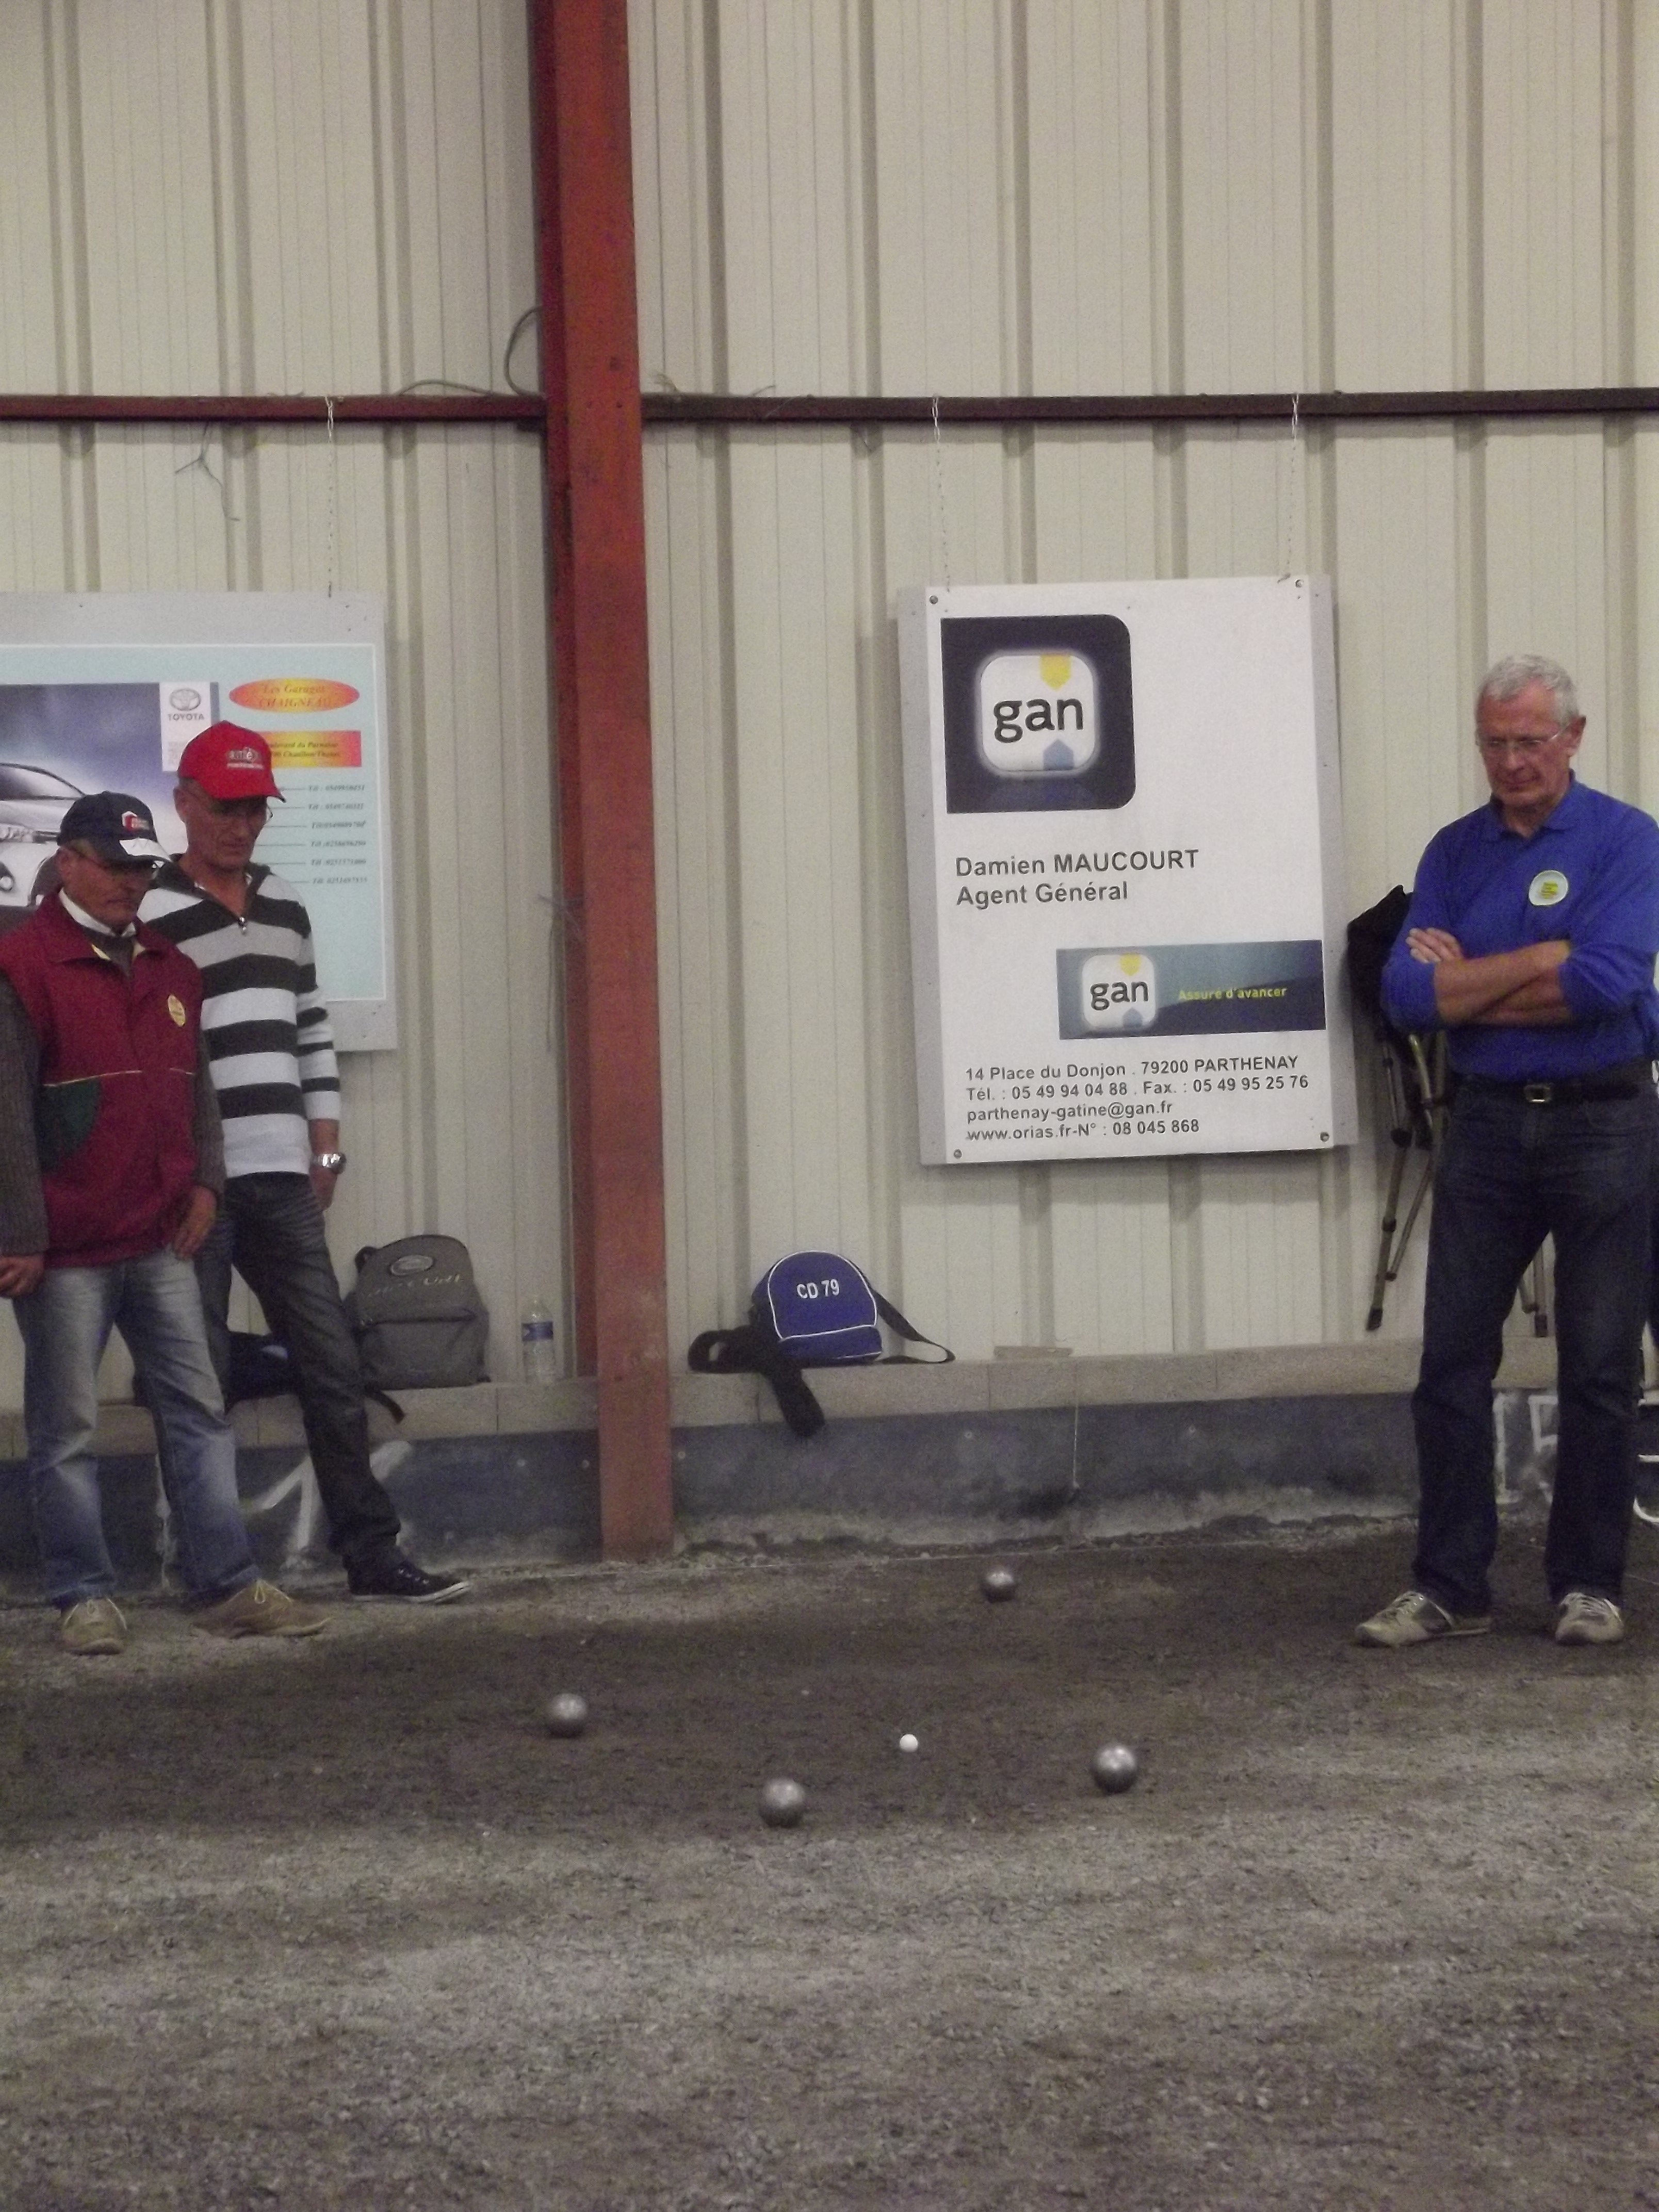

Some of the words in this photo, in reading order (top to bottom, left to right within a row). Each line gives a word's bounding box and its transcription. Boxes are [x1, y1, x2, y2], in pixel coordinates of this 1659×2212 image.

[994, 698, 1083, 743] gan
[956, 855, 1045, 876] Damien
[1053, 849, 1199, 873] MAUCOURT
[956, 884, 1028, 910] Agent
[1035, 881, 1128, 903] Général
[1090, 981, 1149, 1011] gan
[1179, 989, 1222, 1001] Assuré
[1226, 987, 1287, 1000] d'avancer
[966, 1067, 984, 1080] 14
[990, 1066, 1035, 1080] Place
[1040, 1065, 1061, 1079] du
[1066, 1063, 1126, 1080] Donjon
[1141, 1060, 1189, 1075] 79200
[1194, 1055, 1298, 1072] PARTHENAY
[966, 1087, 995, 1100] Tél.
[1012, 1085, 1031, 1099] 05
[1036, 1084, 1055, 1098] 49
[1060, 1084, 1079, 1097] 94
[1085, 1083, 1103, 1097] 04
[1109, 1082, 1128, 1095] 88
[1143, 1081, 1177, 1094] Fax.
[1193, 1079, 1212, 1092] 05
[1217, 1078, 1236, 1091] 49
[1241, 1077, 1260, 1090] 95
[1265, 1076, 1284, 1089] 25
[1290, 1075, 1309, 1088] 76
[967, 1100, 1173, 1125] parthenay-gatine@gan.fr
[1113, 1121, 1132, 1135] 08
[1137, 1120, 1166, 1134] 045
[1171, 1118, 1199, 1133] 868
[796, 1282, 819, 1298] CD
[821, 1279, 840, 1297] 79
